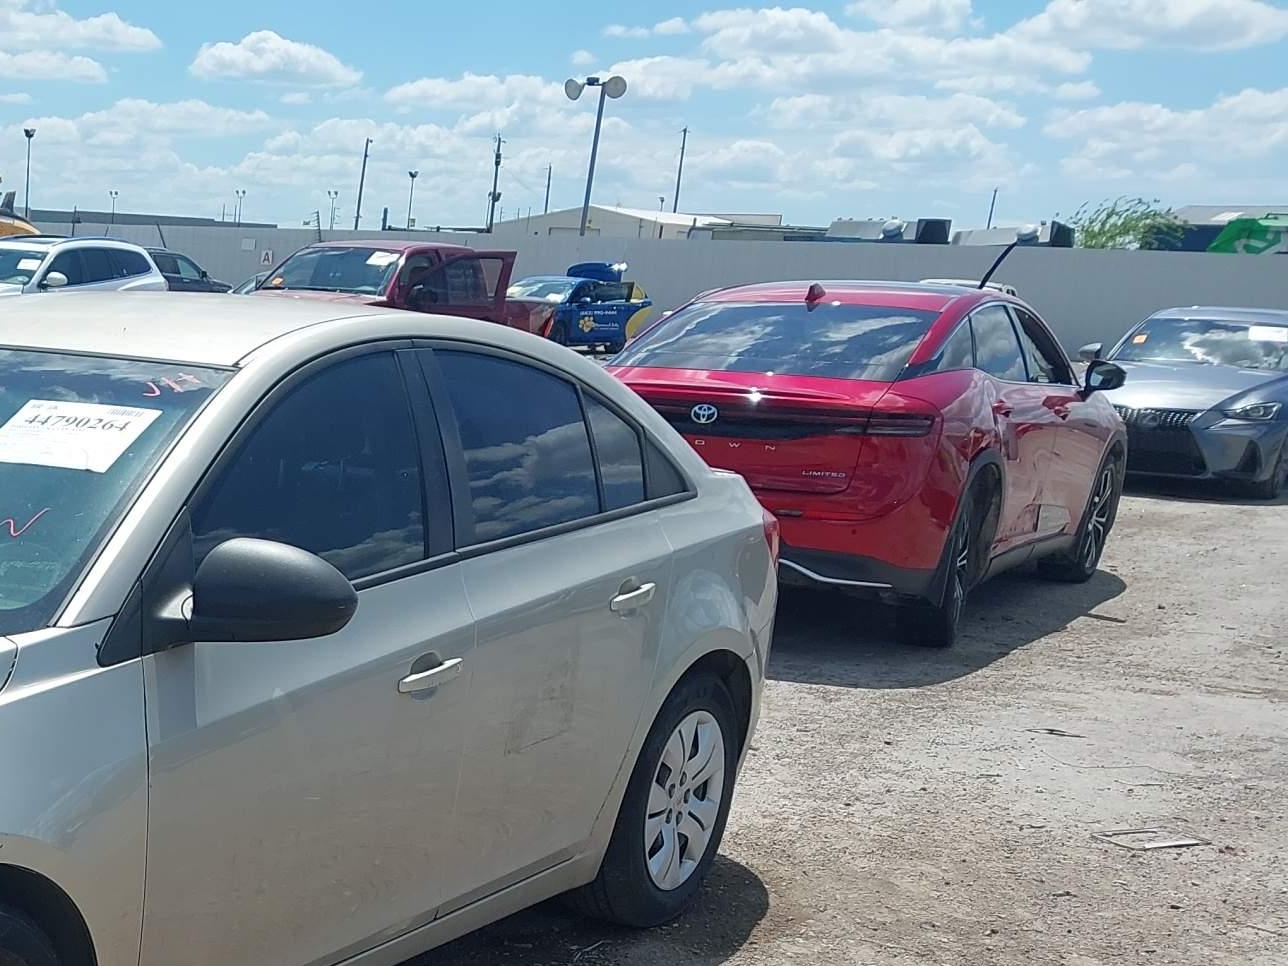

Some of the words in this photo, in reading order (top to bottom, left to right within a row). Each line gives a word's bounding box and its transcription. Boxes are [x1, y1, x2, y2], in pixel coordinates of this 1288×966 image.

[262, 252, 270, 264] A
[25, 413, 132, 432] 44790264
[802, 470, 846, 478] LIMITED
